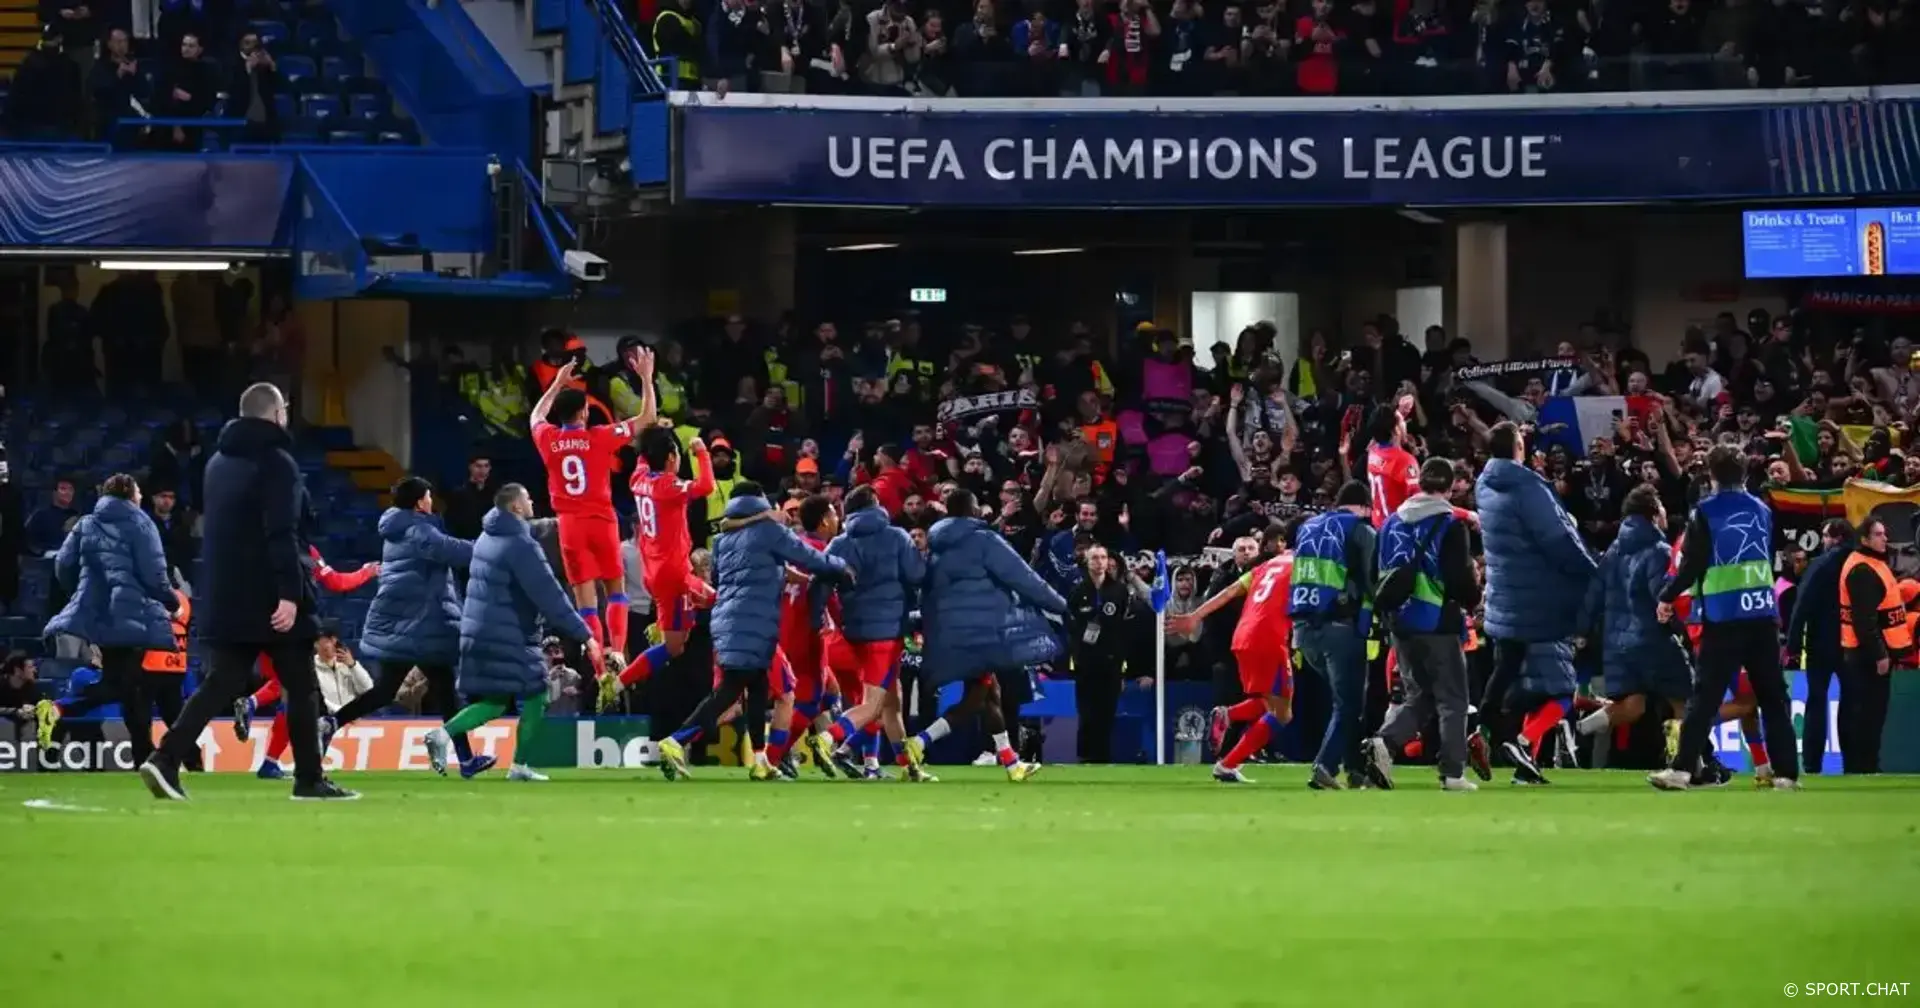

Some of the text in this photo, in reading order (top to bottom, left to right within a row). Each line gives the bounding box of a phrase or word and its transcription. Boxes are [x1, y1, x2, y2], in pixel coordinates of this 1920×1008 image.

[828, 136, 965, 179] UEFA
[984, 137, 1317, 180] CHAMPIONS
[1343, 135, 1547, 179] LEAGUE
[1749, 212, 1845, 226] Drinks & Treats
[1891, 211, 1913, 223] Hot
[551, 438, 590, 453] G.RAMOS
[562, 454, 587, 496] 9
[634, 495, 657, 538] 19
[1253, 565, 1285, 603] 5
[1742, 563, 1768, 585] TV
[1741, 590, 1774, 611] 034
[248, 726, 384, 771] JST
